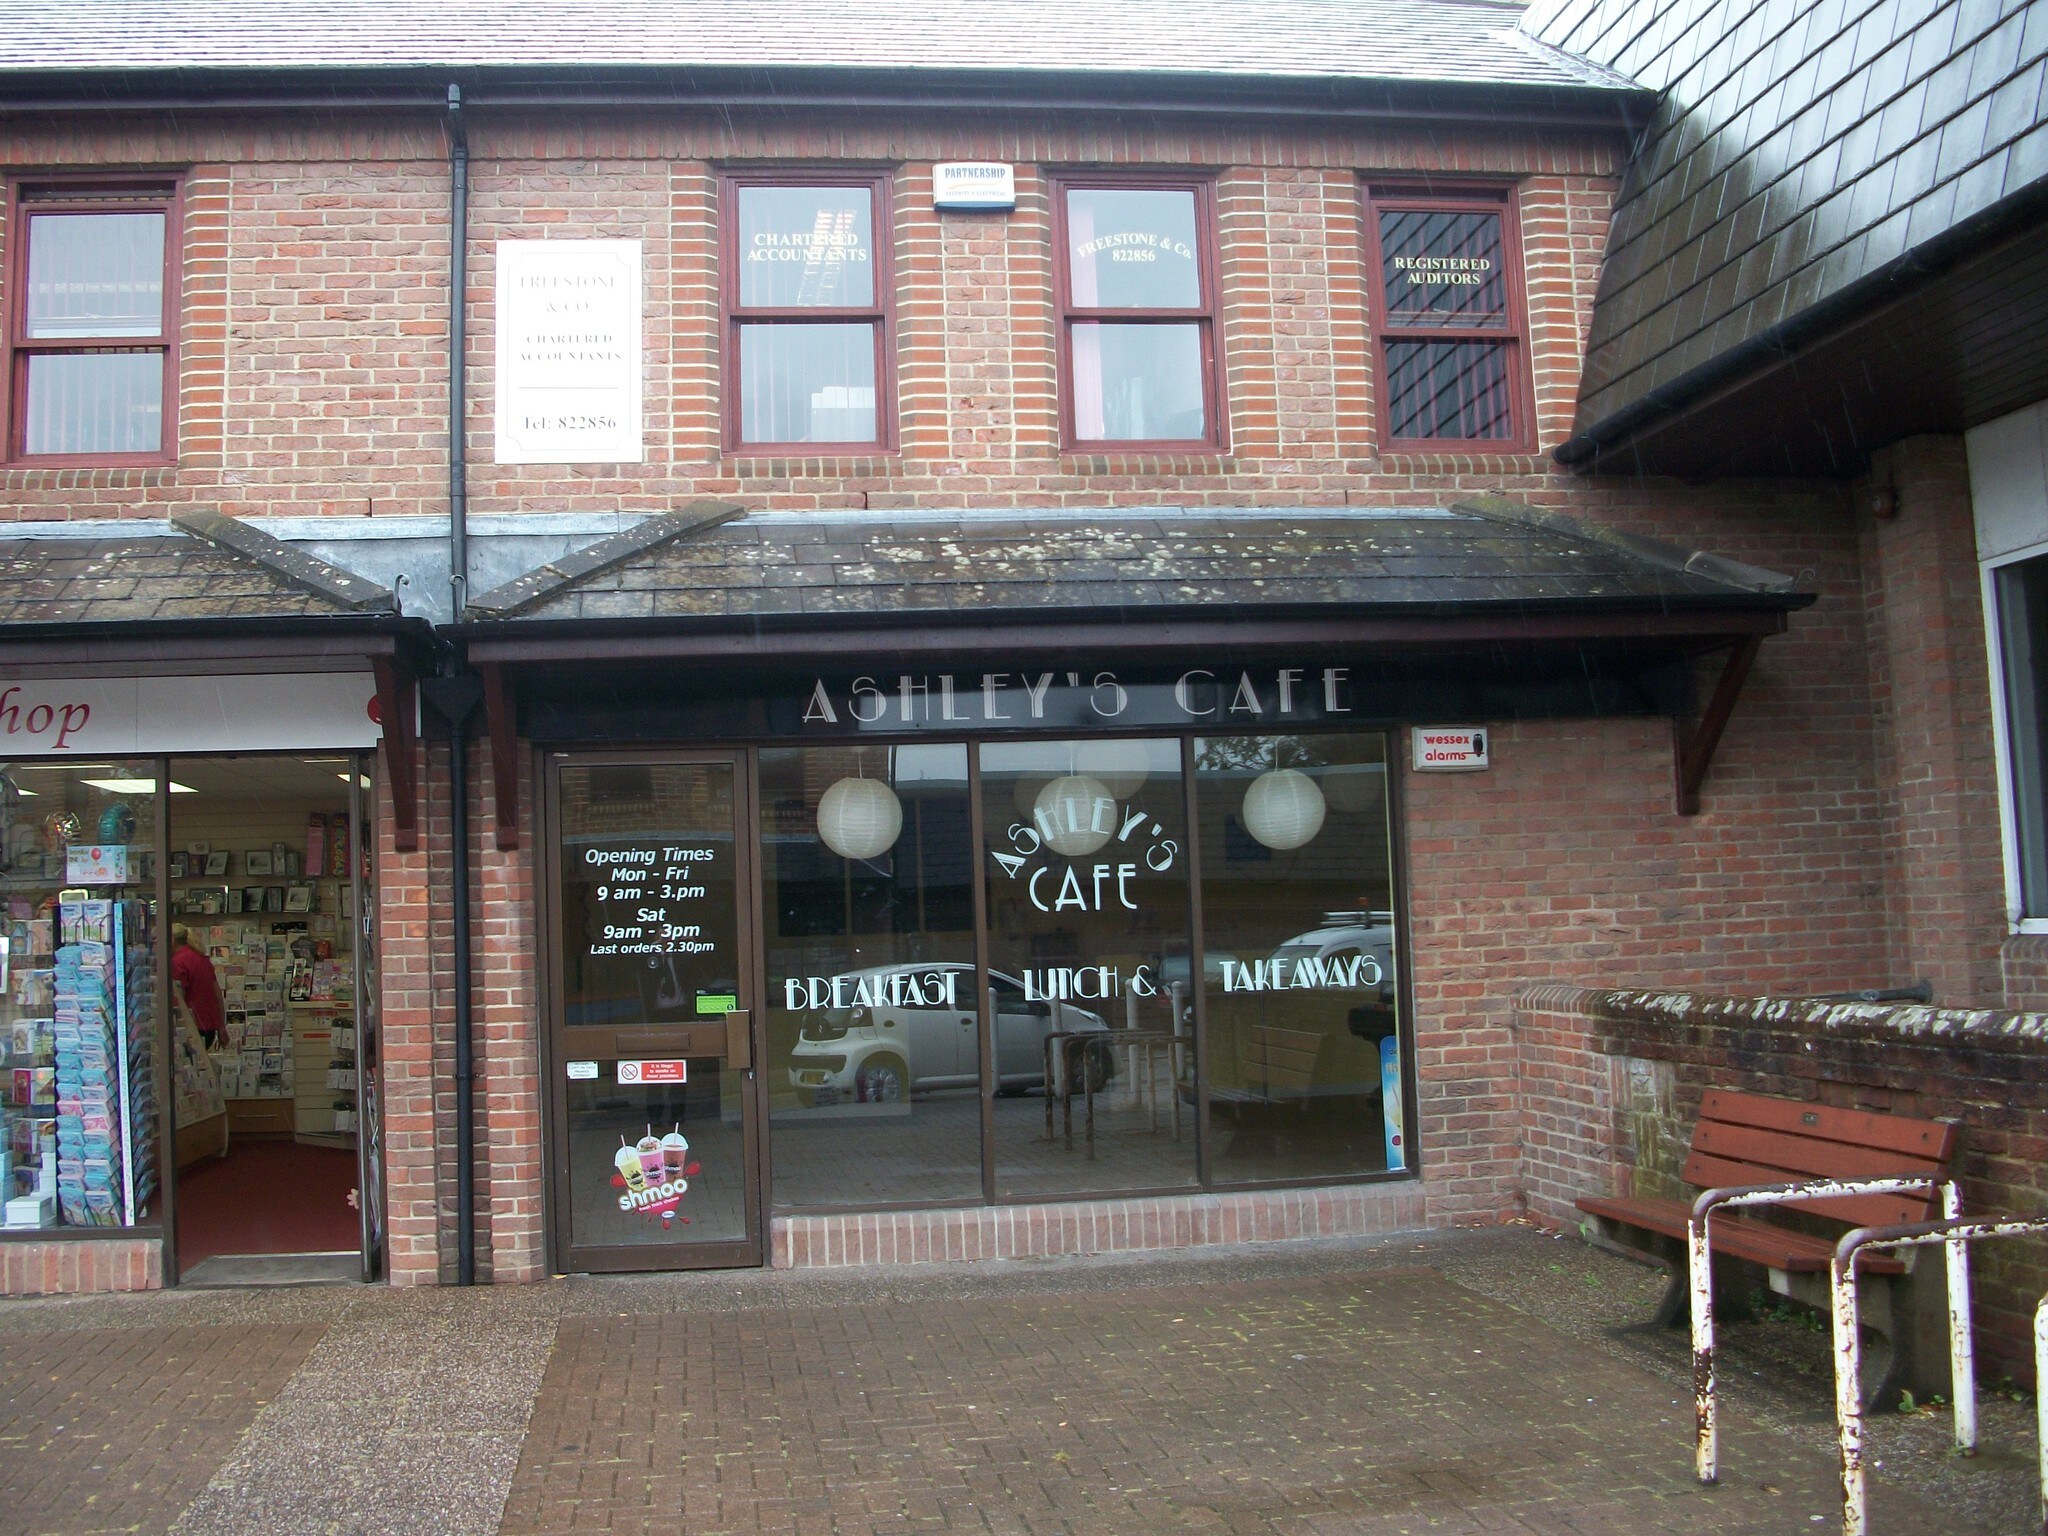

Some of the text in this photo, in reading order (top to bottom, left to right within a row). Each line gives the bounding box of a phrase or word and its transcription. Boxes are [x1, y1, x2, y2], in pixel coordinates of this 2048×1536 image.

[944, 167, 1006, 179] PARTNERSHIP
[754, 233, 859, 246] CHARTERED
[1077, 232, 1158, 259] FREESTONE
[1160, 237, 1171, 250] &
[747, 248, 868, 262] ACCOUNTANTS
[1112, 249, 1156, 262] 822856
[1395, 257, 1491, 271] REGISTERED
[1407, 272, 1481, 285] AUDITORS
[558, 416, 617, 430] 822856
[802, 668, 1352, 724] ASHLEY'S CAFE
[1424, 735, 1470, 745] wessex
[1425, 748, 1467, 761] alarms
[991, 796, 1178, 880] ASHLEY'S
[585, 847, 714, 867] Opening Times
[611, 867, 647, 882] Mon
[665, 866, 690, 880] Fri
[597, 886, 608, 901] 9
[613, 887, 641, 900] am
[660, 885, 705, 902] 3.pm
[1028, 863, 1138, 913] CAFE
[636, 908, 666, 922] Sat
[603, 925, 642, 940] 9am
[660, 924, 700, 941] 3pm
[590, 942, 715, 955] Last orders 2.30pm
[1218, 954, 1383, 992] TAKEAWAYS
[784, 971, 961, 1011] BREAKFAST
[1022, 964, 1157, 1002] LUNCH &
[619, 1179, 688, 1211] shmoo
